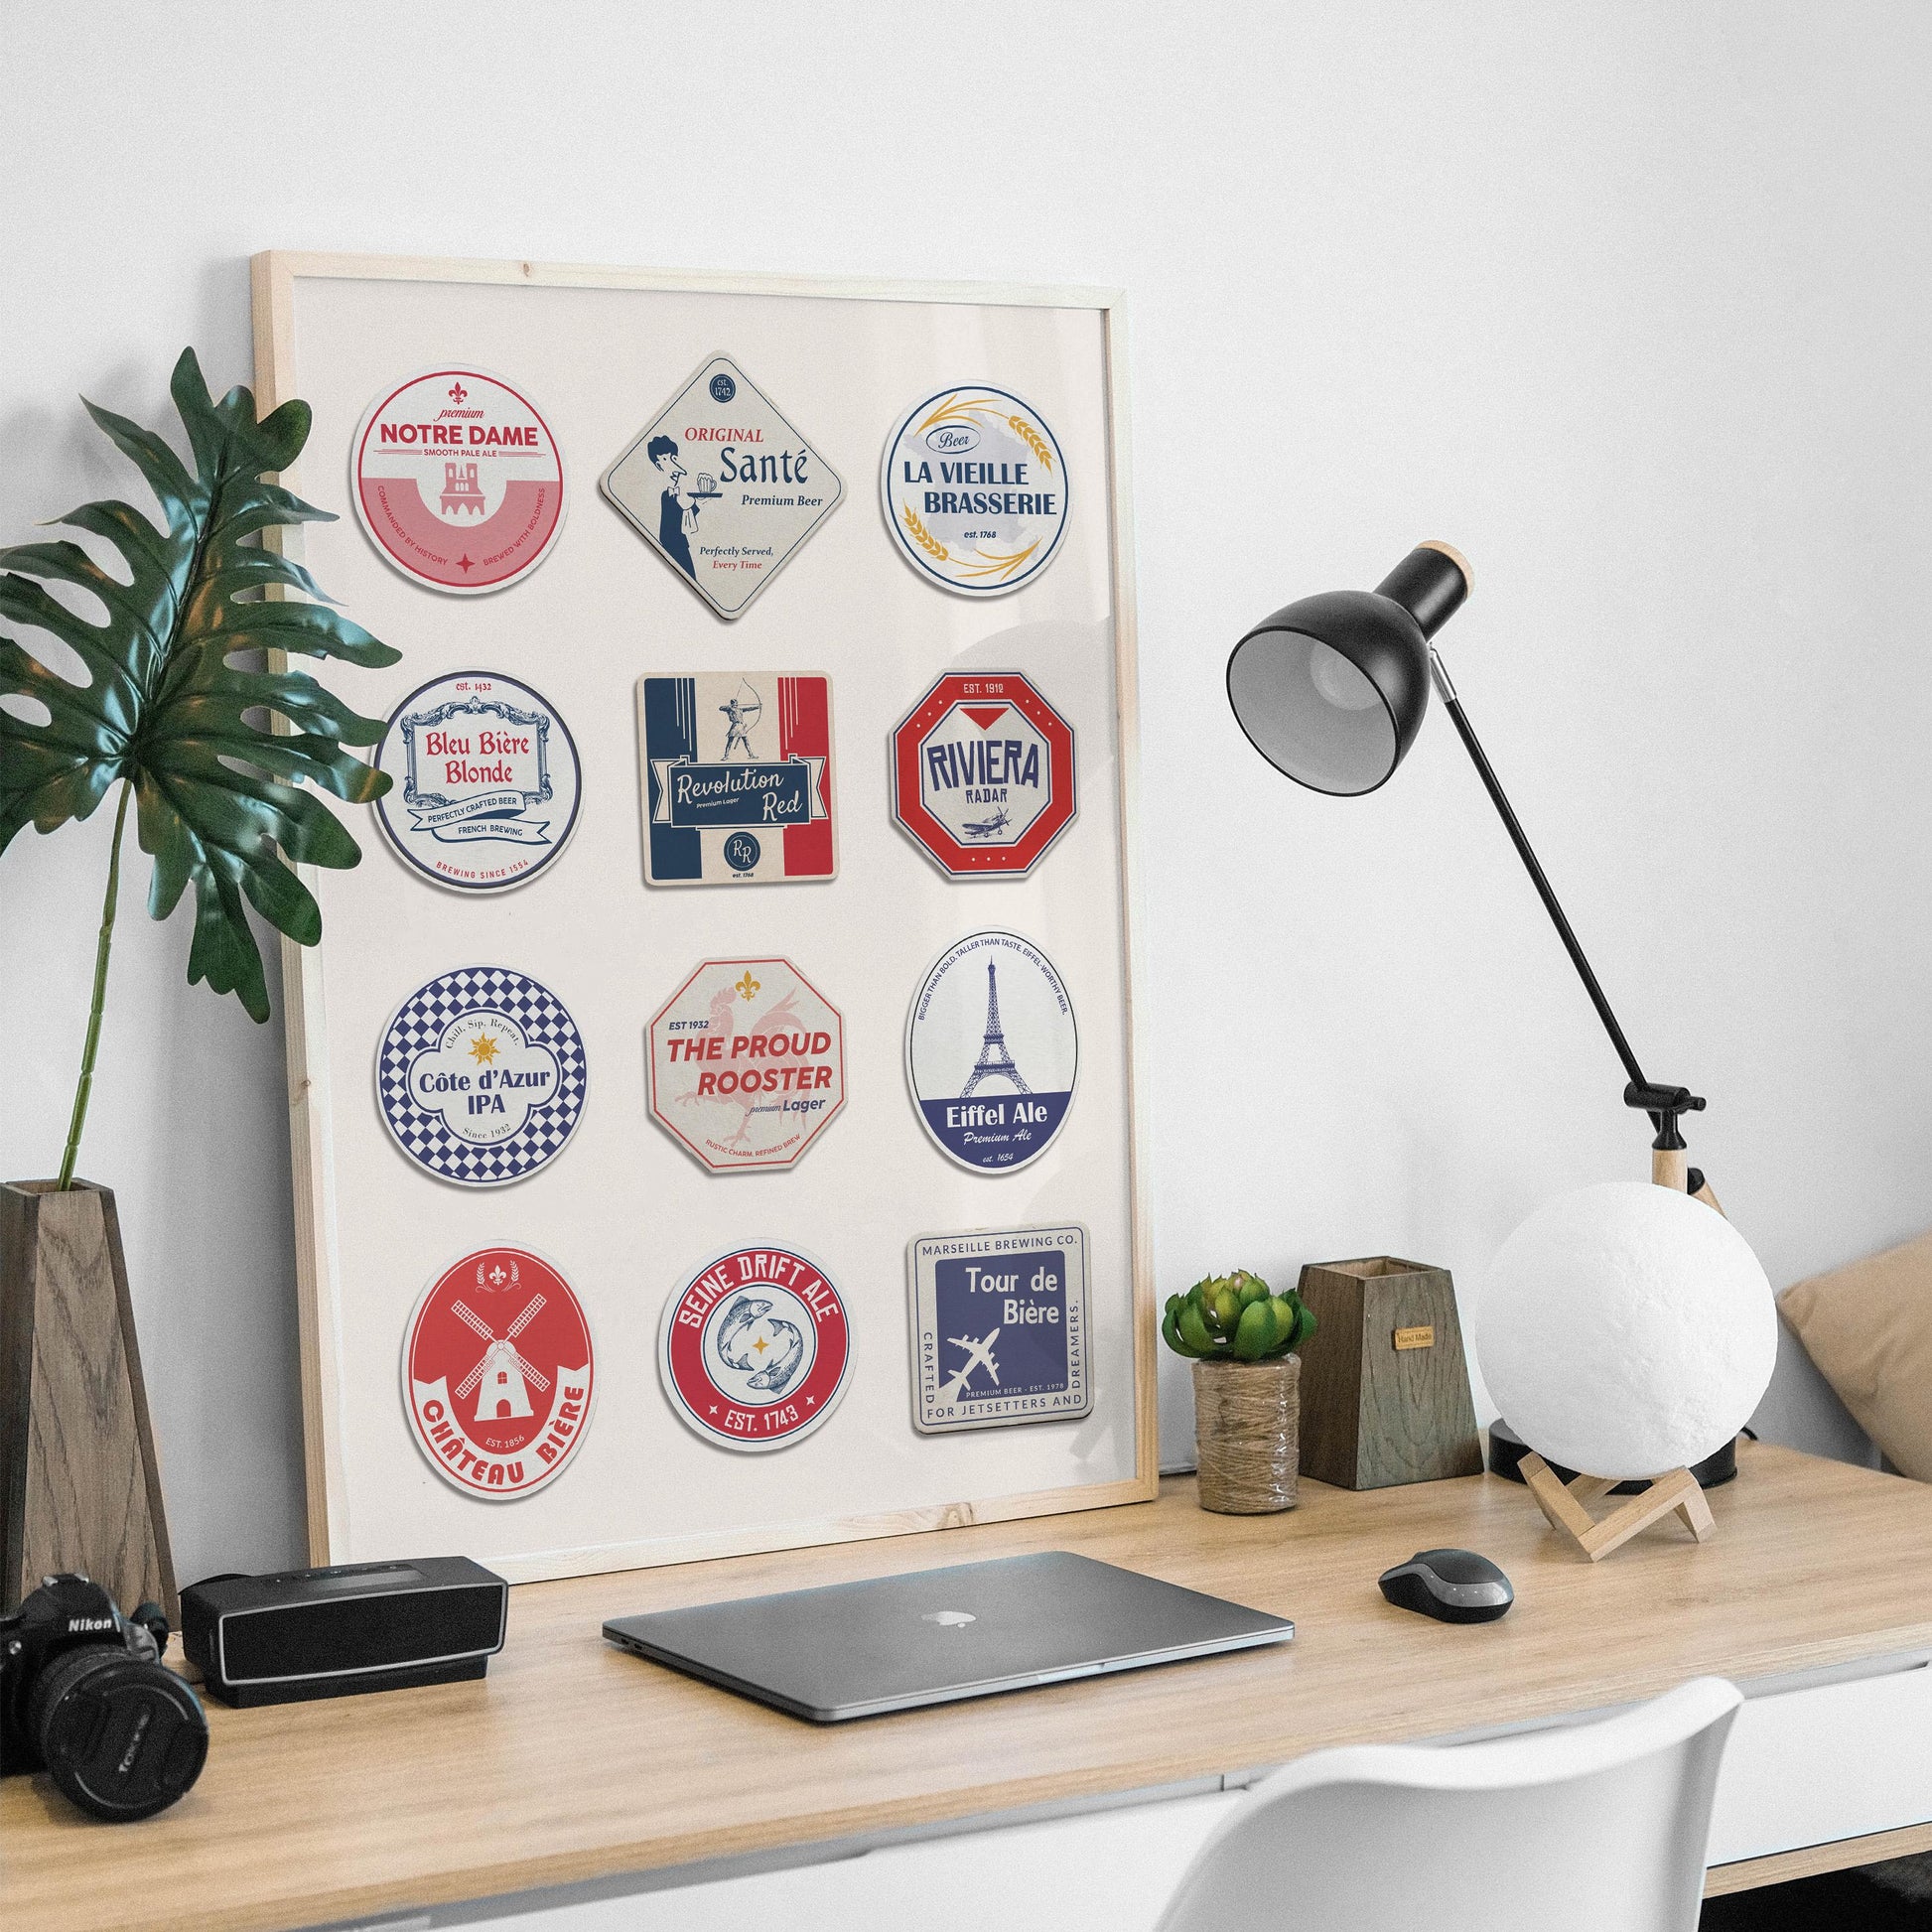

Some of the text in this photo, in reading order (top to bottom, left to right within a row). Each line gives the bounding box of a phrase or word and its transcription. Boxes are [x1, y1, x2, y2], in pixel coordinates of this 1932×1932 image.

[433, 407, 485, 421] premium
[380, 424, 538, 446] NOTRE DAME
[685, 427, 764, 442] ORIGINAL
[938, 432, 970, 449] Beer
[720, 447, 808, 483] Santé
[904, 462, 1029, 484] LA VIEILLE
[742, 494, 823, 506] Premium Beer
[924, 491, 1057, 514] BRASSERIE
[377, 485, 448, 566] COMMANDED BY HISTORY
[483, 487, 545, 566] BREWED WITH BOLDNESS
[700, 547, 773, 557] Perfectly Served,
[713, 561, 737, 571] Every
[456, 681, 491, 692] est. 1432
[964, 683, 982, 694] EST.
[426, 731, 529, 756] Bleu Bière
[445, 759, 512, 783] Blonde
[927, 740, 1038, 791] RIVIERA
[677, 768, 784, 805] Revolution
[966, 788, 1007, 804] RADAR
[428, 808, 465, 823] PERFECTLY
[466, 798, 497, 813] CRAFTED
[696, 797, 740, 808] Premium Lager
[762, 790, 802, 822] Red
[459, 824, 523, 836] FRENCH BREWING
[436, 860, 528, 879] BREWING SINCE 1554
[918, 994, 931, 1021] BIGGER
[928, 973, 942, 996] THAN
[940, 956, 958, 975] BOLD.
[955, 940, 980, 958] TALLER
[1001, 938, 1023, 953] TASTE.
[1023, 947, 1062, 995] EIFFEL-WORTHY
[1056, 994, 1068, 1016] BEER.
[667, 1032, 832, 1062] THE PROUD
[419, 1072, 471, 1093] Côte
[698, 1065, 833, 1095] ROOSTER
[468, 1094, 505, 1115] IPA
[746, 1098, 826, 1117] premium Lager
[946, 1101, 1047, 1128] Eiffel Ale
[462, 1124, 511, 1139] Since 1932
[964, 1129, 1033, 1145] Premium Ale
[705, 1139, 728, 1154] RUSTIC
[756, 1145, 783, 1157] REFINED
[922, 1235, 1077, 1256] MARSEILLE BREWING CO.
[679, 1254, 839, 1328] SEINE DRIFT ALE
[965, 1267, 1057, 1293] Tour de
[1003, 1299, 1059, 1324] Bière
[1069, 1300, 1080, 1388] DREAMERS.
[923, 1332, 934, 1404] CRAFTED
[966, 1389, 1002, 1398] PREMIUM
[927, 1394, 1082, 1419] FOR JETSETTERS AND
[725, 1404, 799, 1432] EST. 1743
[423, 1386, 585, 1485] CHÂTEAU BIÈRE
[485, 1435, 525, 1449] EST. 1856
[69, 1618, 112, 1632] Nikon
